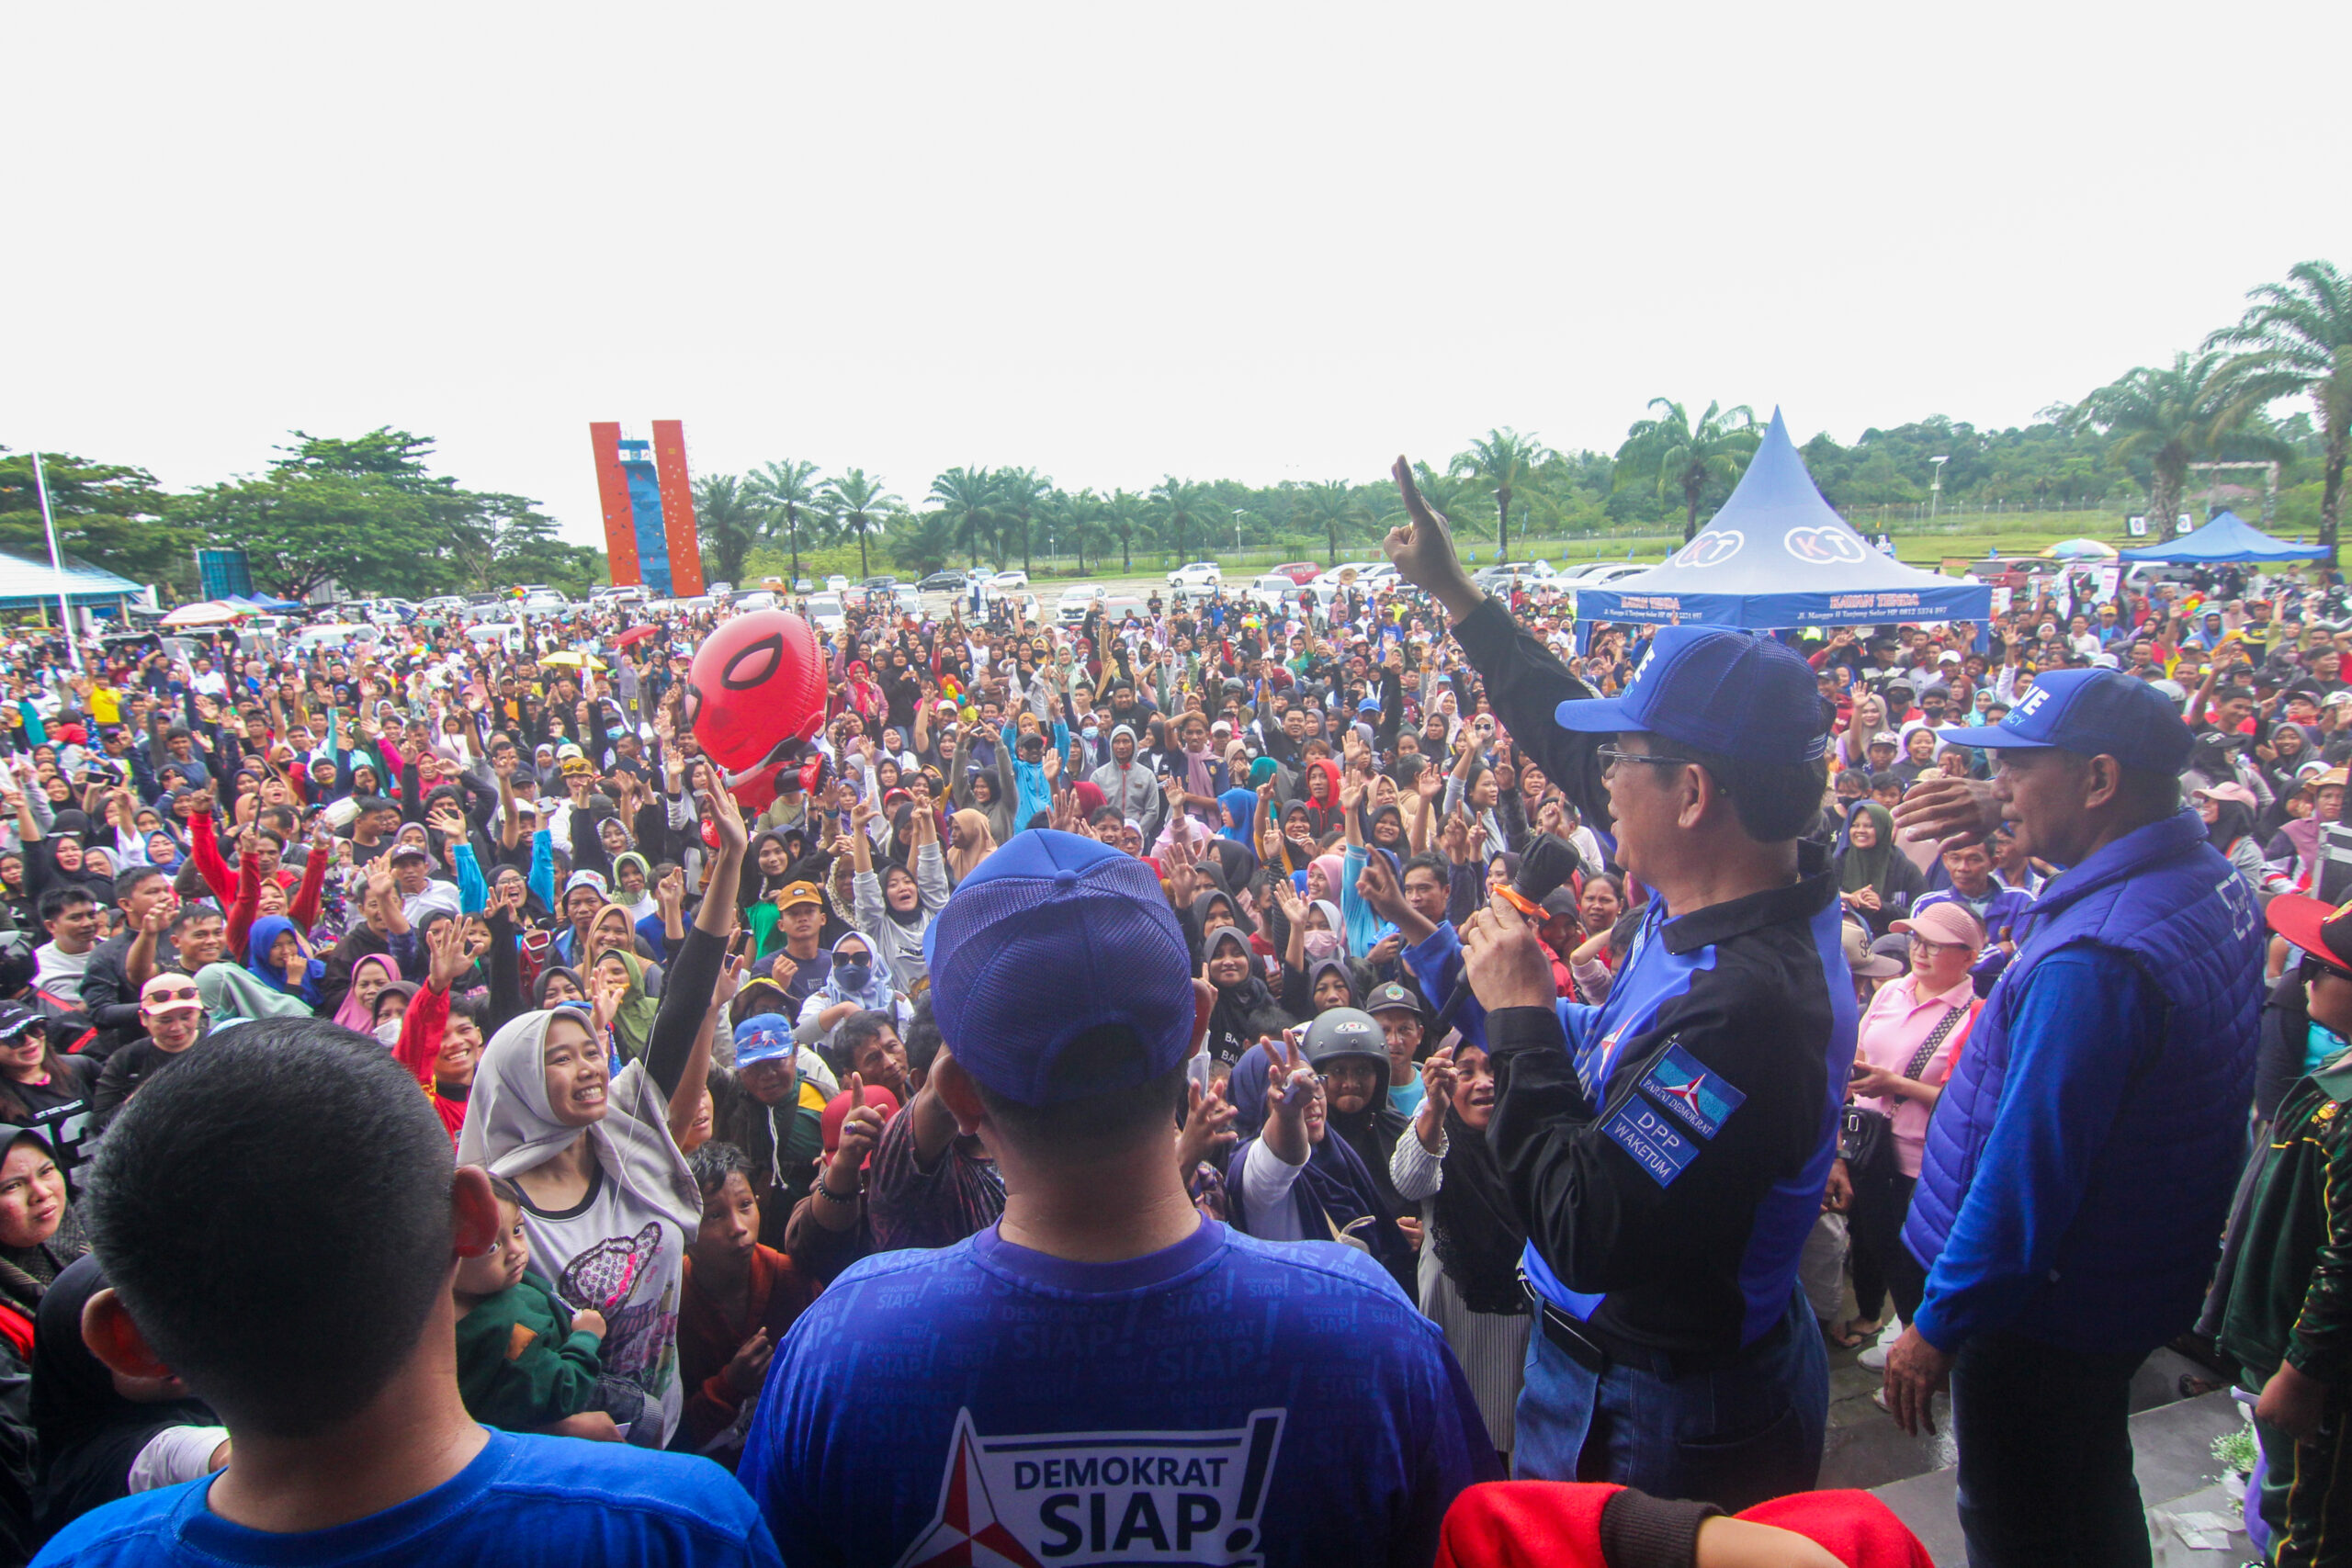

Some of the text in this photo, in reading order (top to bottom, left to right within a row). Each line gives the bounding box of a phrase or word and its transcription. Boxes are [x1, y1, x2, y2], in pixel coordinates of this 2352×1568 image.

[1795, 535, 1850, 557] KT
[1876, 593, 1919, 607] TENDA
[1643, 1078, 1713, 1135] PARTAI DEMOKRAT
[1637, 1111, 1680, 1148] DPP
[1613, 1122, 1672, 1179] WAKETUM
[1014, 1457, 1228, 1490] DEMOKRAT
[1040, 1418, 1278, 1557] SIAP!
